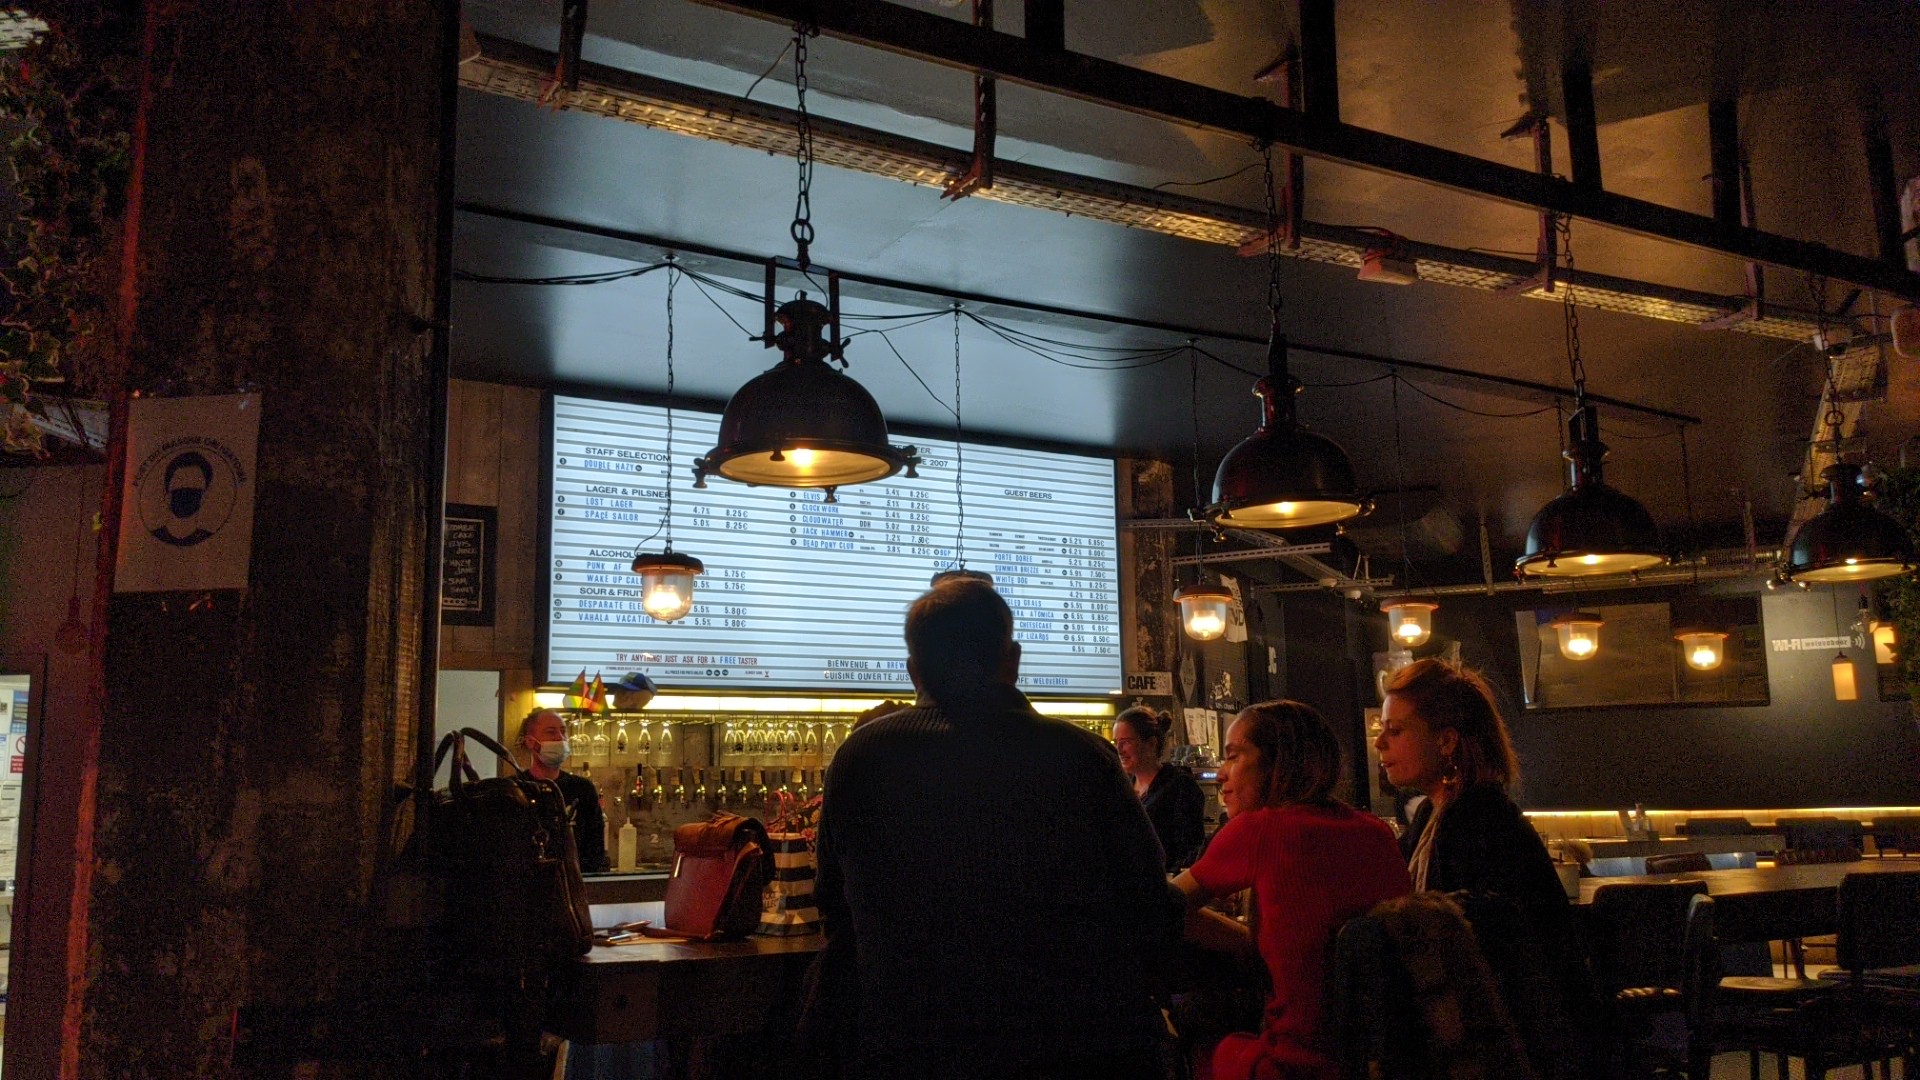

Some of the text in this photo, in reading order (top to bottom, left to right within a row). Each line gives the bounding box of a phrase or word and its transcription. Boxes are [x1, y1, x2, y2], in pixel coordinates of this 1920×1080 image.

[585, 447, 671, 462] STAFF SELECTION
[584, 459, 634, 471] DOUBLE HAZY
[586, 485, 618, 495] LAGER
[631, 488, 671, 499] PILSNER
[803, 492, 820, 501] ELVIS
[1004, 489, 1052, 500] GUEST BEERS
[585, 497, 633, 508] LOST LAGER
[693, 506, 710, 514] 4.7%
[585, 510, 639, 521] SPACE SAILOR
[693, 519, 710, 527] 5.0%
[802, 527, 849, 538] JACK HAMMER
[802, 539, 818, 548] DEAD
[821, 540, 837, 549] PONY
[839, 541, 854, 550] CLUB
[589, 549, 634, 558] ALCOHOL
[994, 553, 1012, 561] PORTE
[586, 561, 622, 570] PUNK AF
[724, 569, 746, 578] 5.75€
[587, 574, 609, 583] WAKE
[612, 575, 623, 584] UP
[995, 576, 1014, 584] WHITE
[724, 582, 746, 591] 5.75€
[579, 587, 607, 595] SOUR
[608, 588, 616, 596] &
[579, 600, 623, 610] DESPARATE
[578, 613, 609, 622] VAHALA
[616, 653, 628, 662] TRY
[665, 654, 678, 663] JUST
[682, 656, 694, 664] ASK
[697, 656, 708, 664] FOR
[711, 656, 716, 664] A
[720, 656, 736, 665] FREE
[738, 656, 758, 666] TASTER
[827, 660, 868, 669] BIENVENUE
[1127, 672, 1157, 690] CAFÉ
